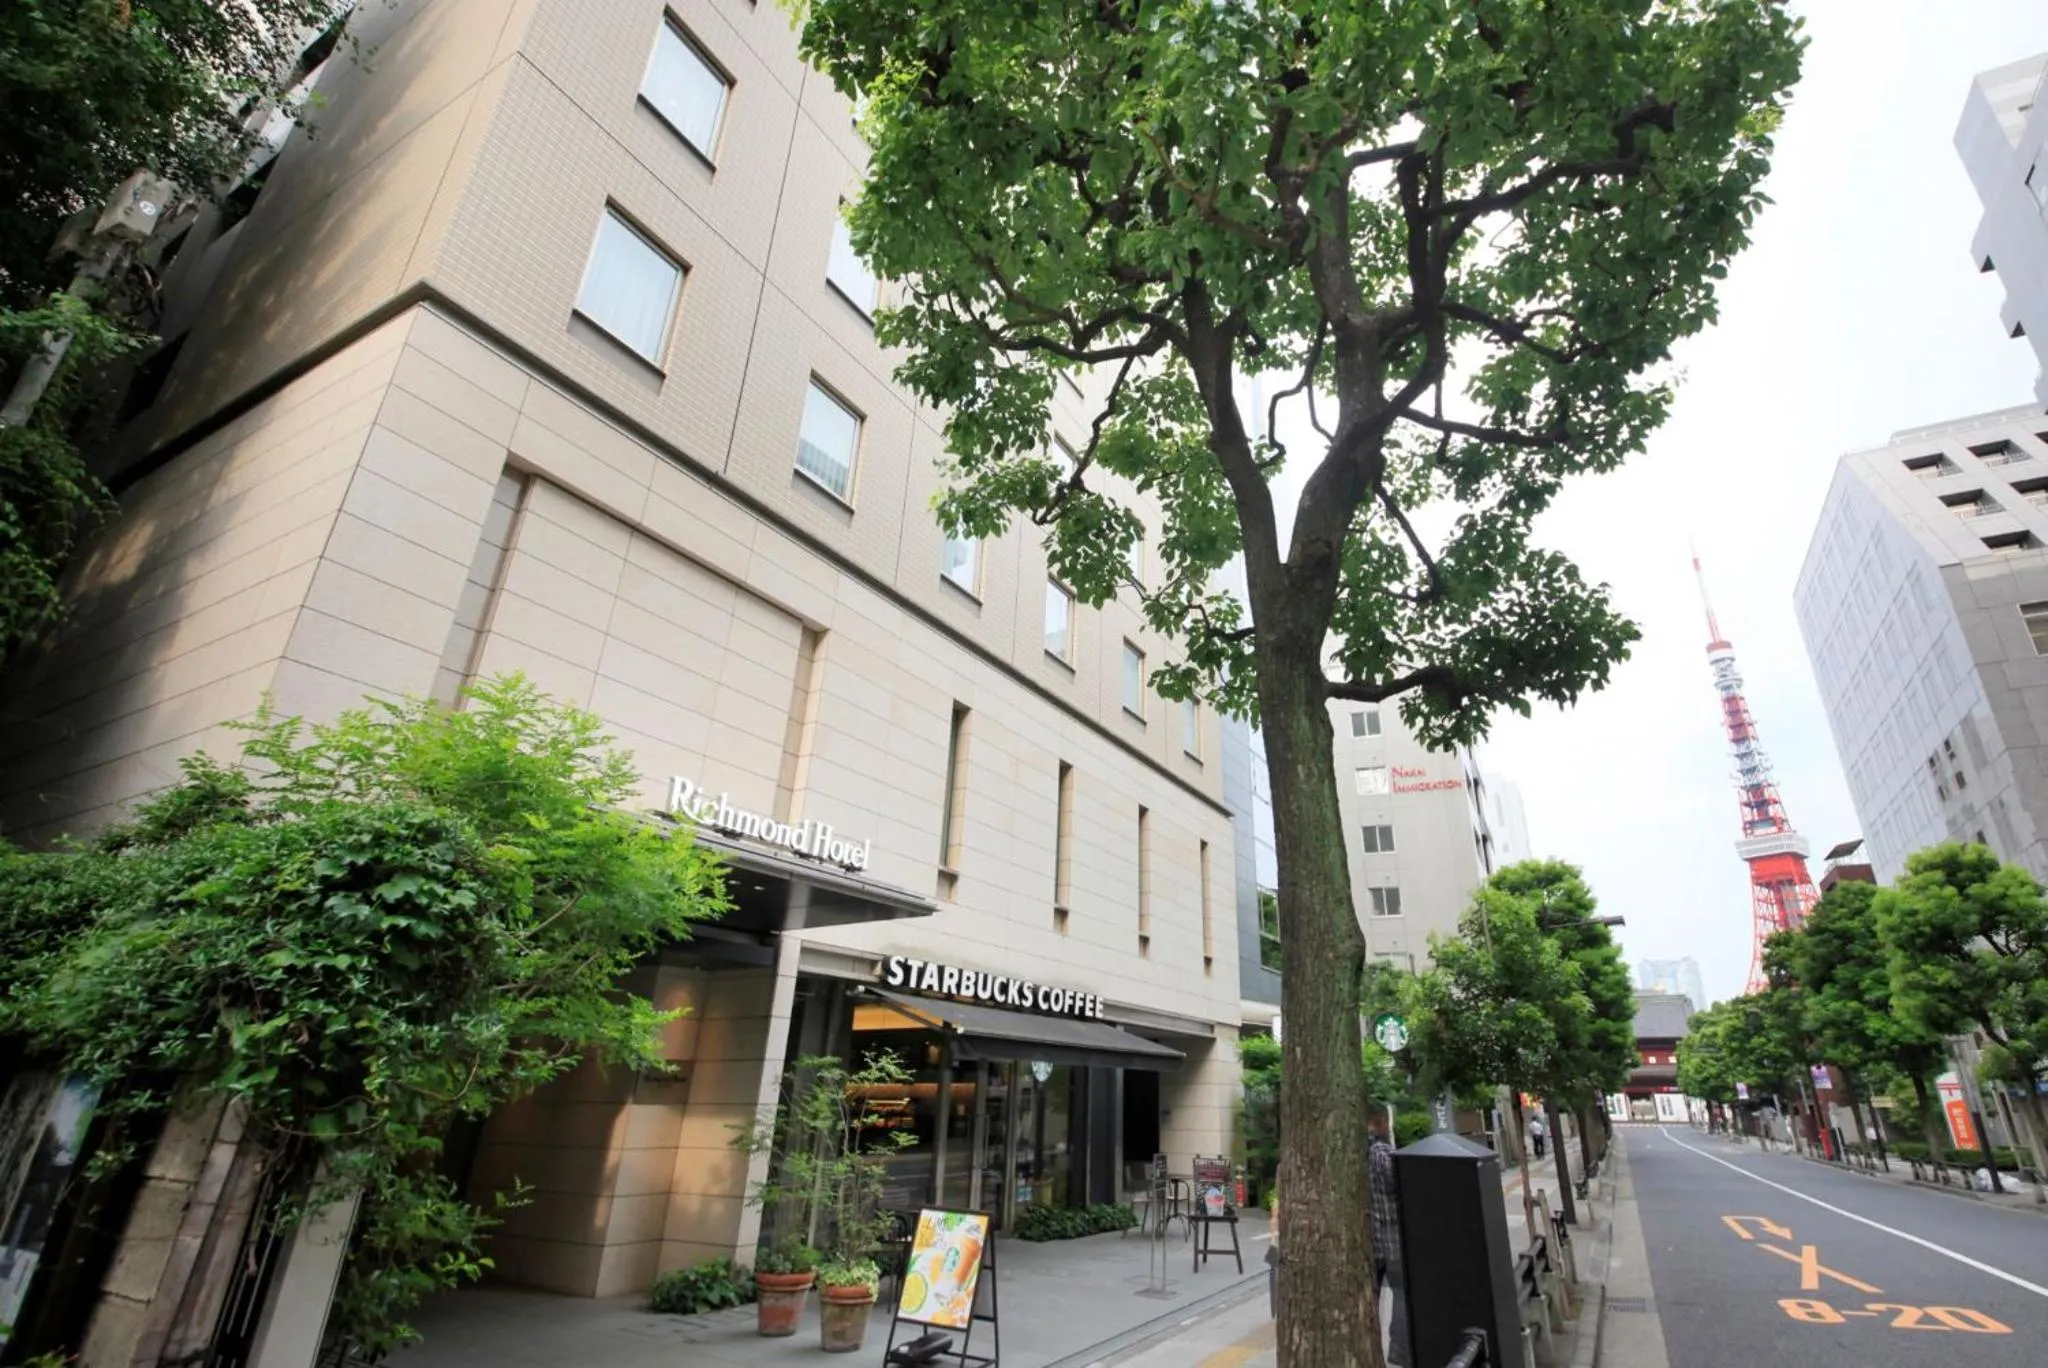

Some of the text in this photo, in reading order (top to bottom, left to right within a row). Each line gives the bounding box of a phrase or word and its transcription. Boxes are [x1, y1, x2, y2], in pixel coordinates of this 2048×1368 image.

[670, 775, 871, 870] Richmond Hotel
[887, 955, 1104, 1019] STARBUCKS COFFEE
[1776, 1298, 2014, 1334] 8-20
